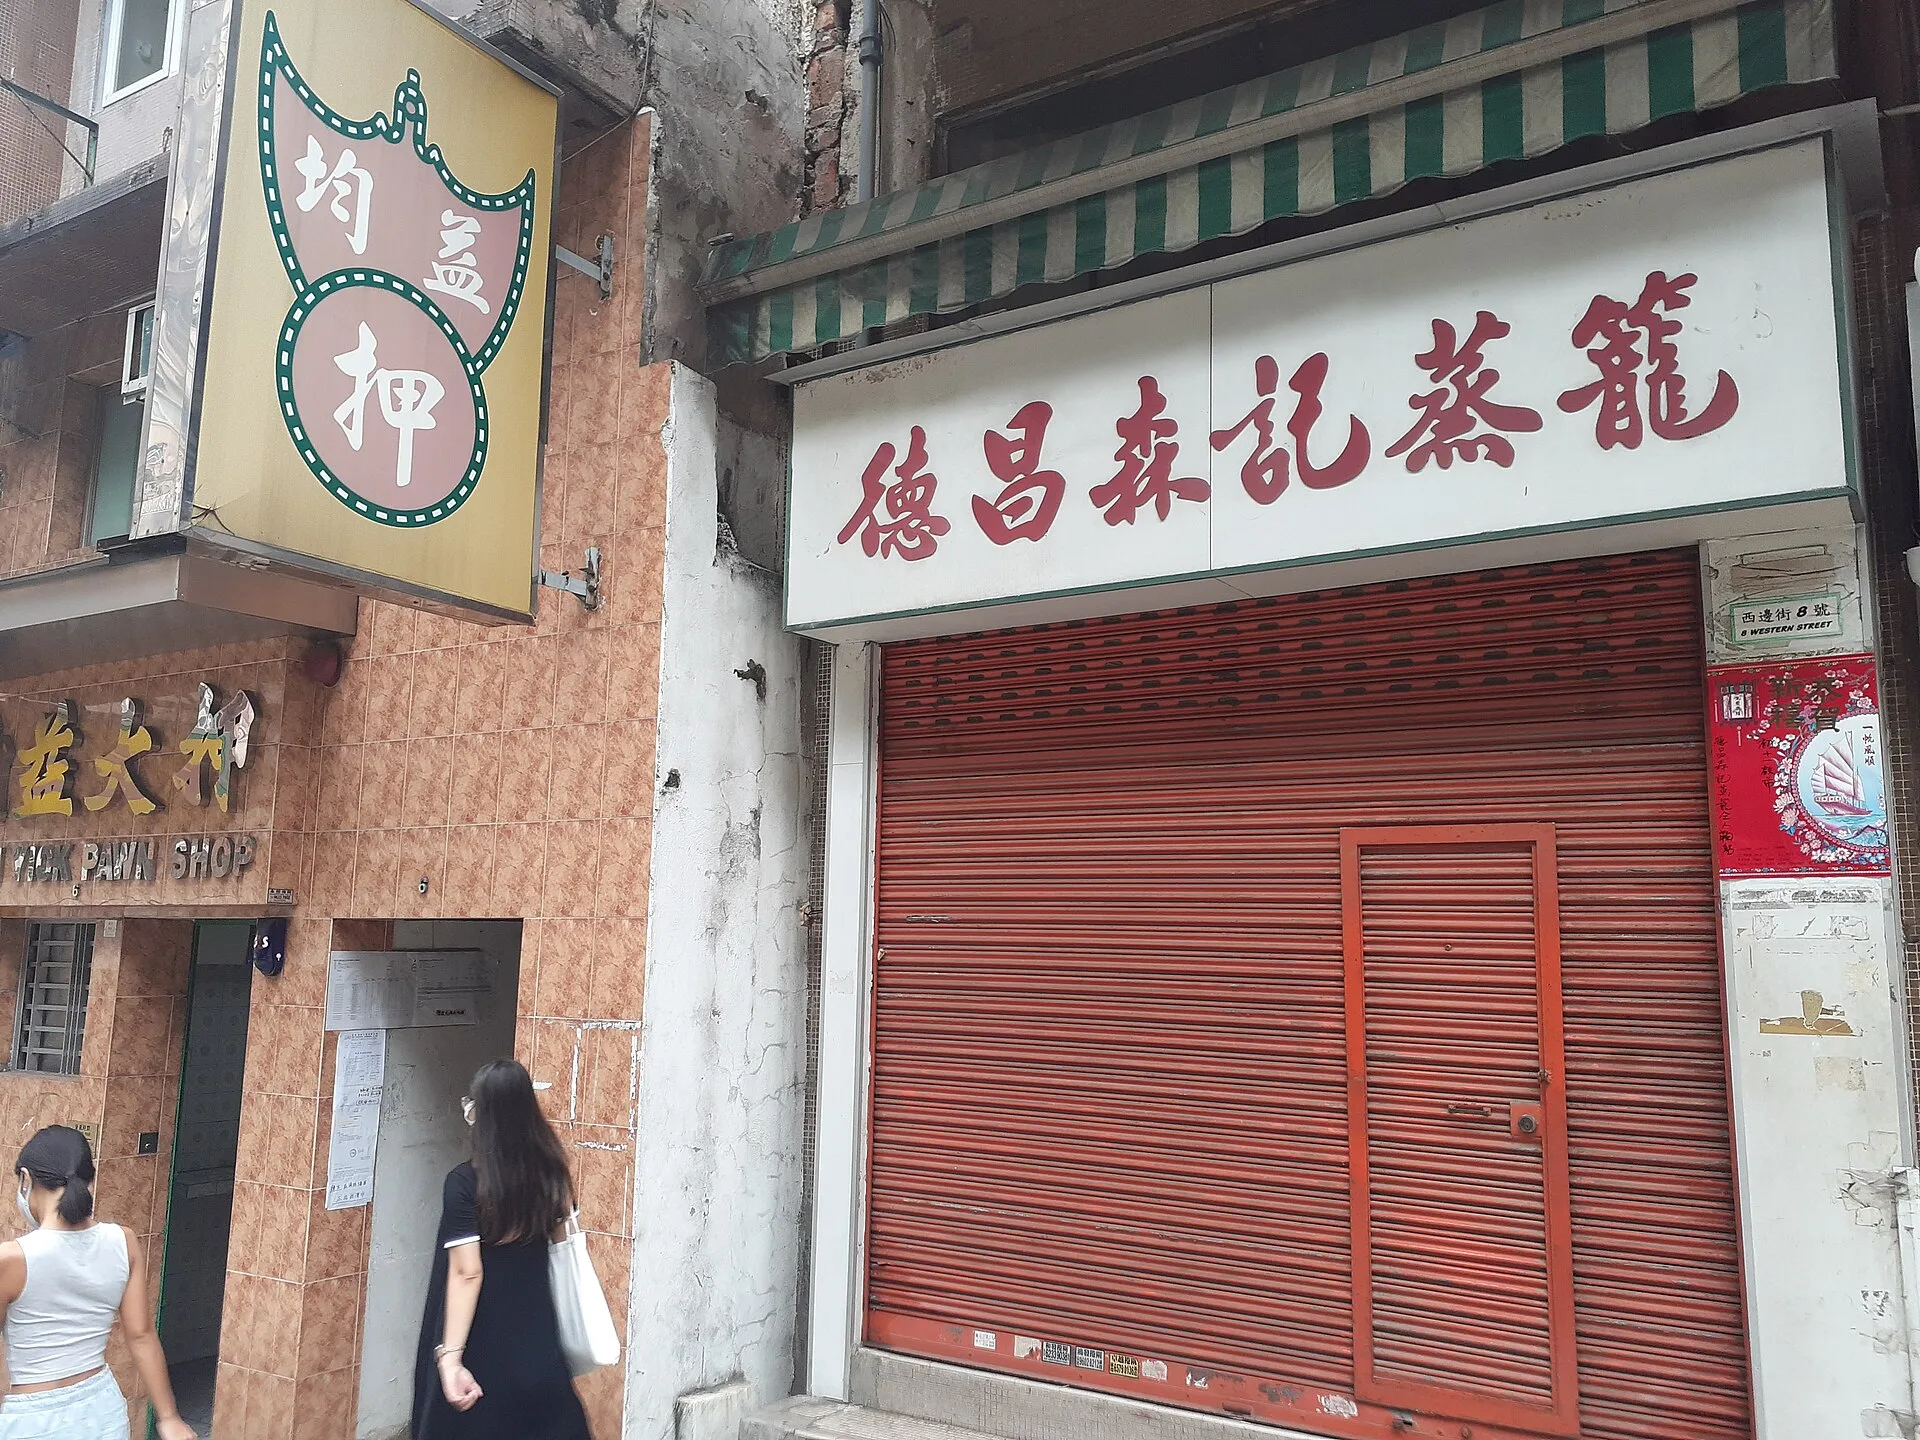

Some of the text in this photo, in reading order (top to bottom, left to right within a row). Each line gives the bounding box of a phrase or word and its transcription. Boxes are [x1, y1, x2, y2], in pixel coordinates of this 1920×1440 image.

[332, 320, 446, 488] 押
[838, 270, 1740, 562] 德昌森記蒸籠
[1740, 620, 1833, 637] 8 WESTERN STREET
[13, 843, 73, 882] YICK
[80, 838, 157, 882] PAWN
[170, 836, 257, 880] SHOP
[72, 884, 80, 897] 6
